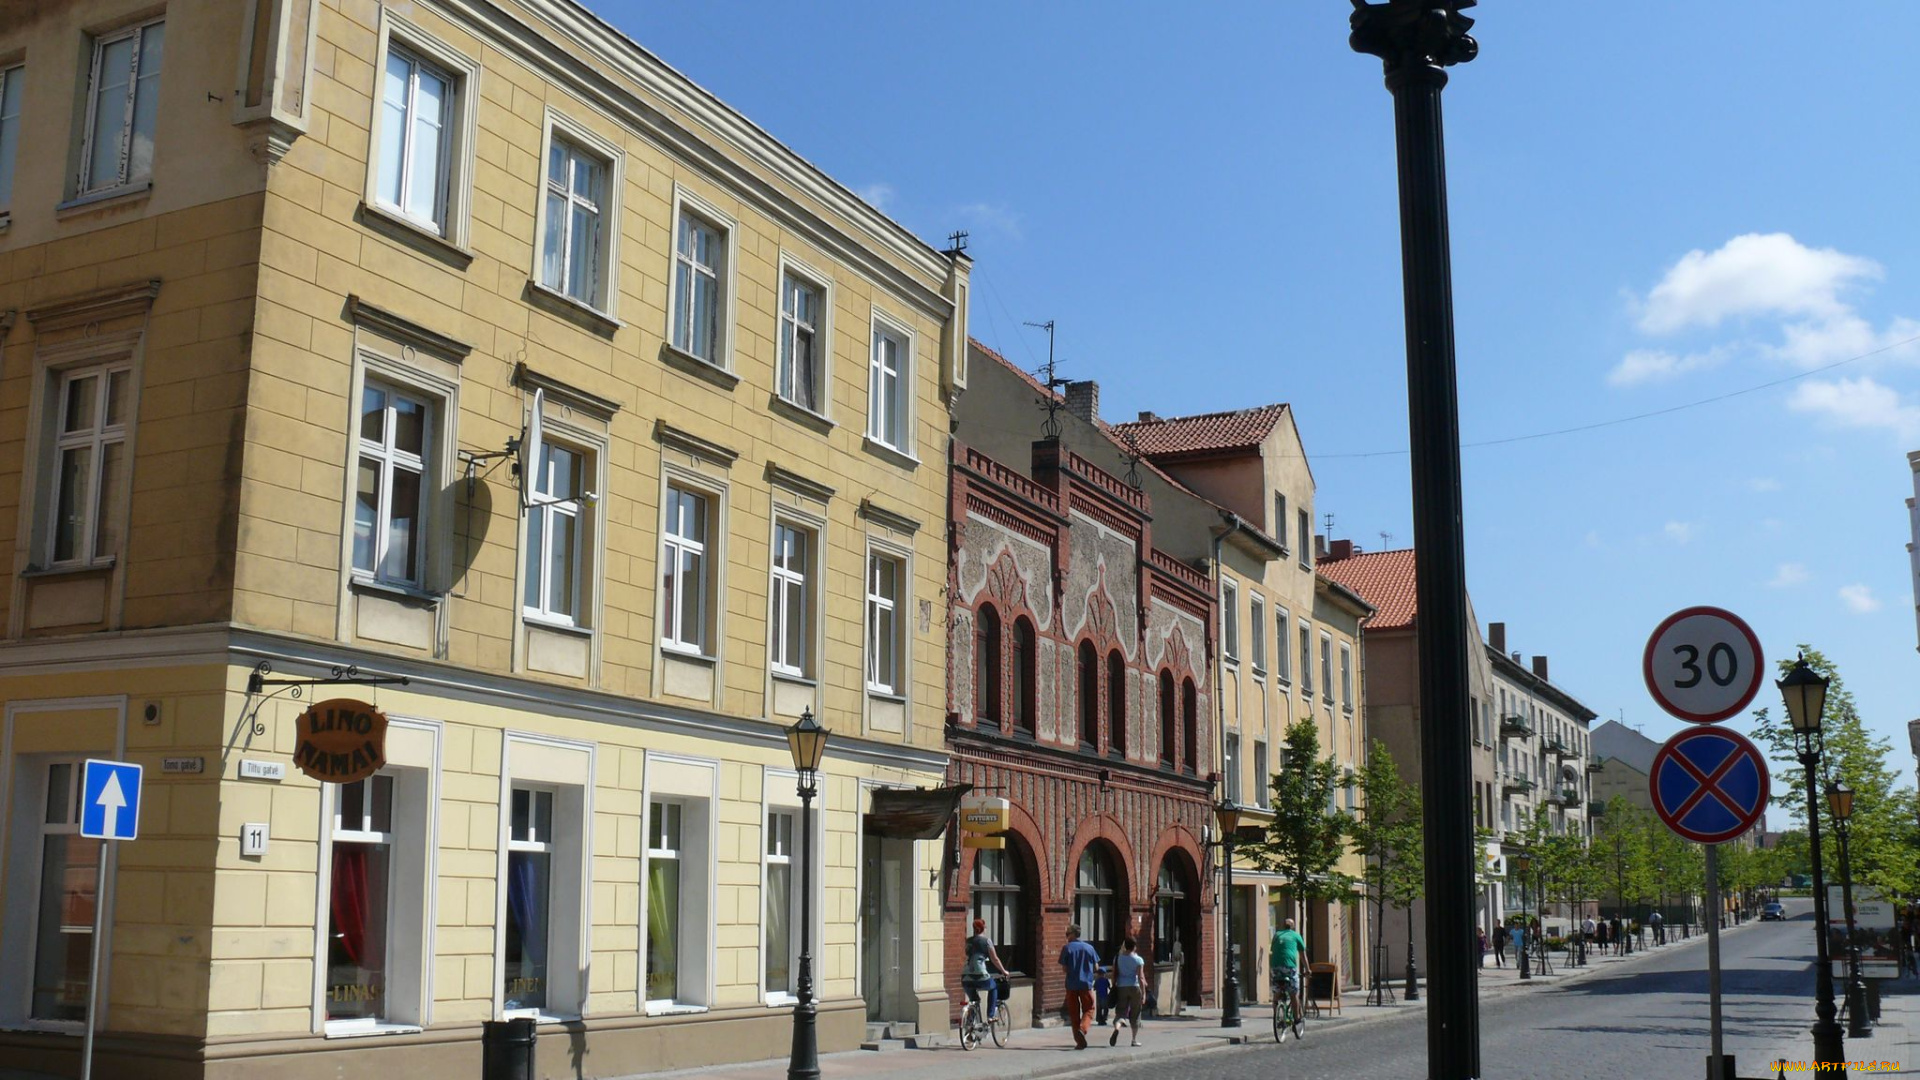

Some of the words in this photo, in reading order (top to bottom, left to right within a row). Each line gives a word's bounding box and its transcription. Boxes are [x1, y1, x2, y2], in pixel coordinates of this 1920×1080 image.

[1672, 642, 1737, 689] 30
[308, 708, 373, 735] LINO
[301, 739, 378, 777] NAMAI
[250, 829, 262, 848] 11
[333, 983, 377, 1002] LINAS
